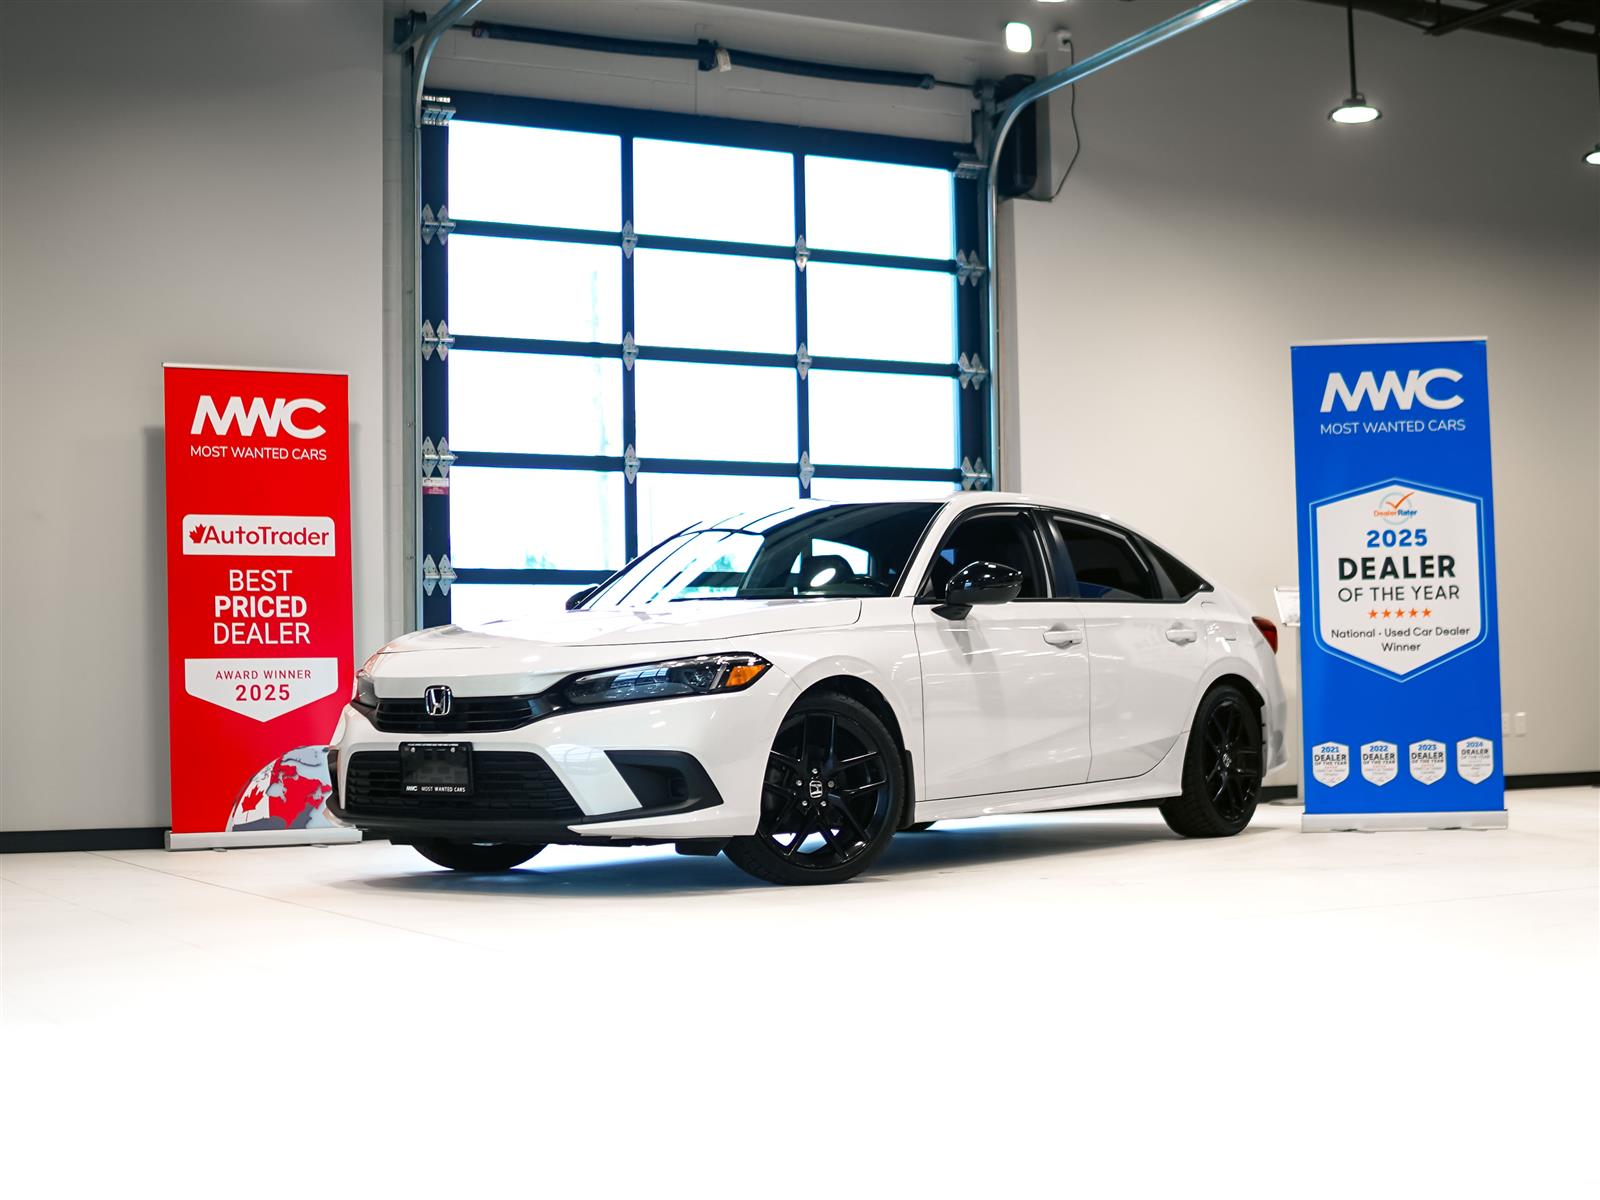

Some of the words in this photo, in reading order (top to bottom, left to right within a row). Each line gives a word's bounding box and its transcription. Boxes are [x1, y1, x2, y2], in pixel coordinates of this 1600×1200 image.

[1320, 368, 1465, 413] MWC
[190, 395, 327, 440] MWC
[1320, 422, 1359, 435] MOST
[1363, 420, 1425, 433] WANTED
[1428, 419, 1466, 431] CARS
[190, 446, 228, 457] MOST
[231, 447, 288, 460] WANTED
[291, 449, 327, 461] CARS
[203, 525, 329, 546] AutoTrader
[1366, 529, 1428, 548] 2025
[1338, 555, 1456, 581] DEALER
[229, 569, 293, 592] BEST
[1338, 587, 1363, 602] OF
[1369, 586, 1405, 602] THE
[1411, 585, 1460, 600] YEAR
[214, 595, 308, 618] PRICED
[213, 622, 311, 645] DEALER
[1331, 628, 1376, 638] National
[1384, 628, 1411, 637] Used
[1412, 627, 1433, 637] Car
[1435, 626, 1470, 636] Dealer
[1381, 642, 1421, 652] Winner
[215, 670, 259, 680] AWARD
[263, 669, 312, 679] WINNER
[235, 684, 291, 702] 2025
[1314, 754, 1347, 762] DEALER
[1362, 753, 1396, 761] DEALER
[1411, 752, 1444, 760] DEALER
